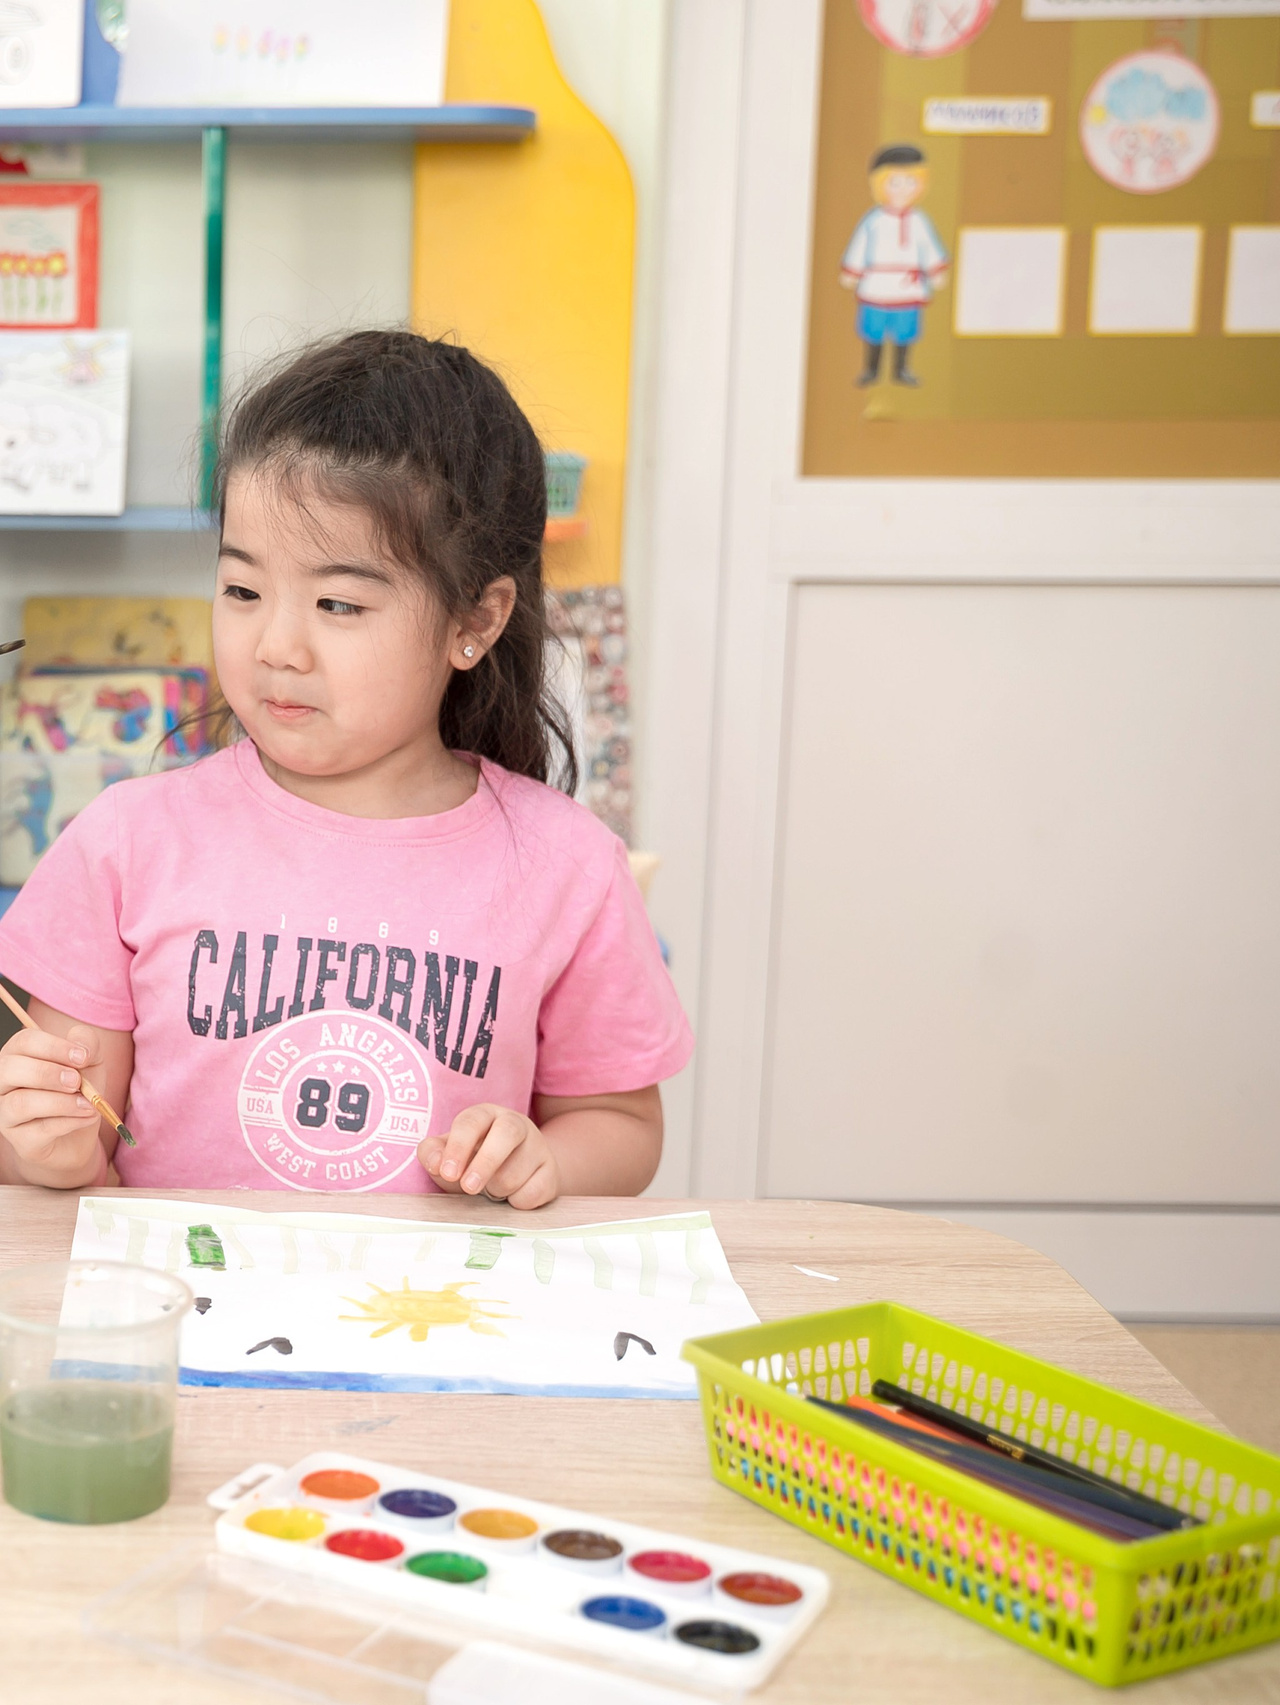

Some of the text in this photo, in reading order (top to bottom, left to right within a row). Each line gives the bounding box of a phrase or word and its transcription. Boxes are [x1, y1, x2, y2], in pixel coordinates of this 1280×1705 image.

[187, 930, 501, 1078] CALIFORNIA
[255, 1022, 419, 1102] LOS ANGELES
[246, 1097, 274, 1115] USA
[294, 1076, 371, 1134] 89
[390, 1116, 419, 1133] USA
[263, 1133, 391, 1181] WEST COAST
